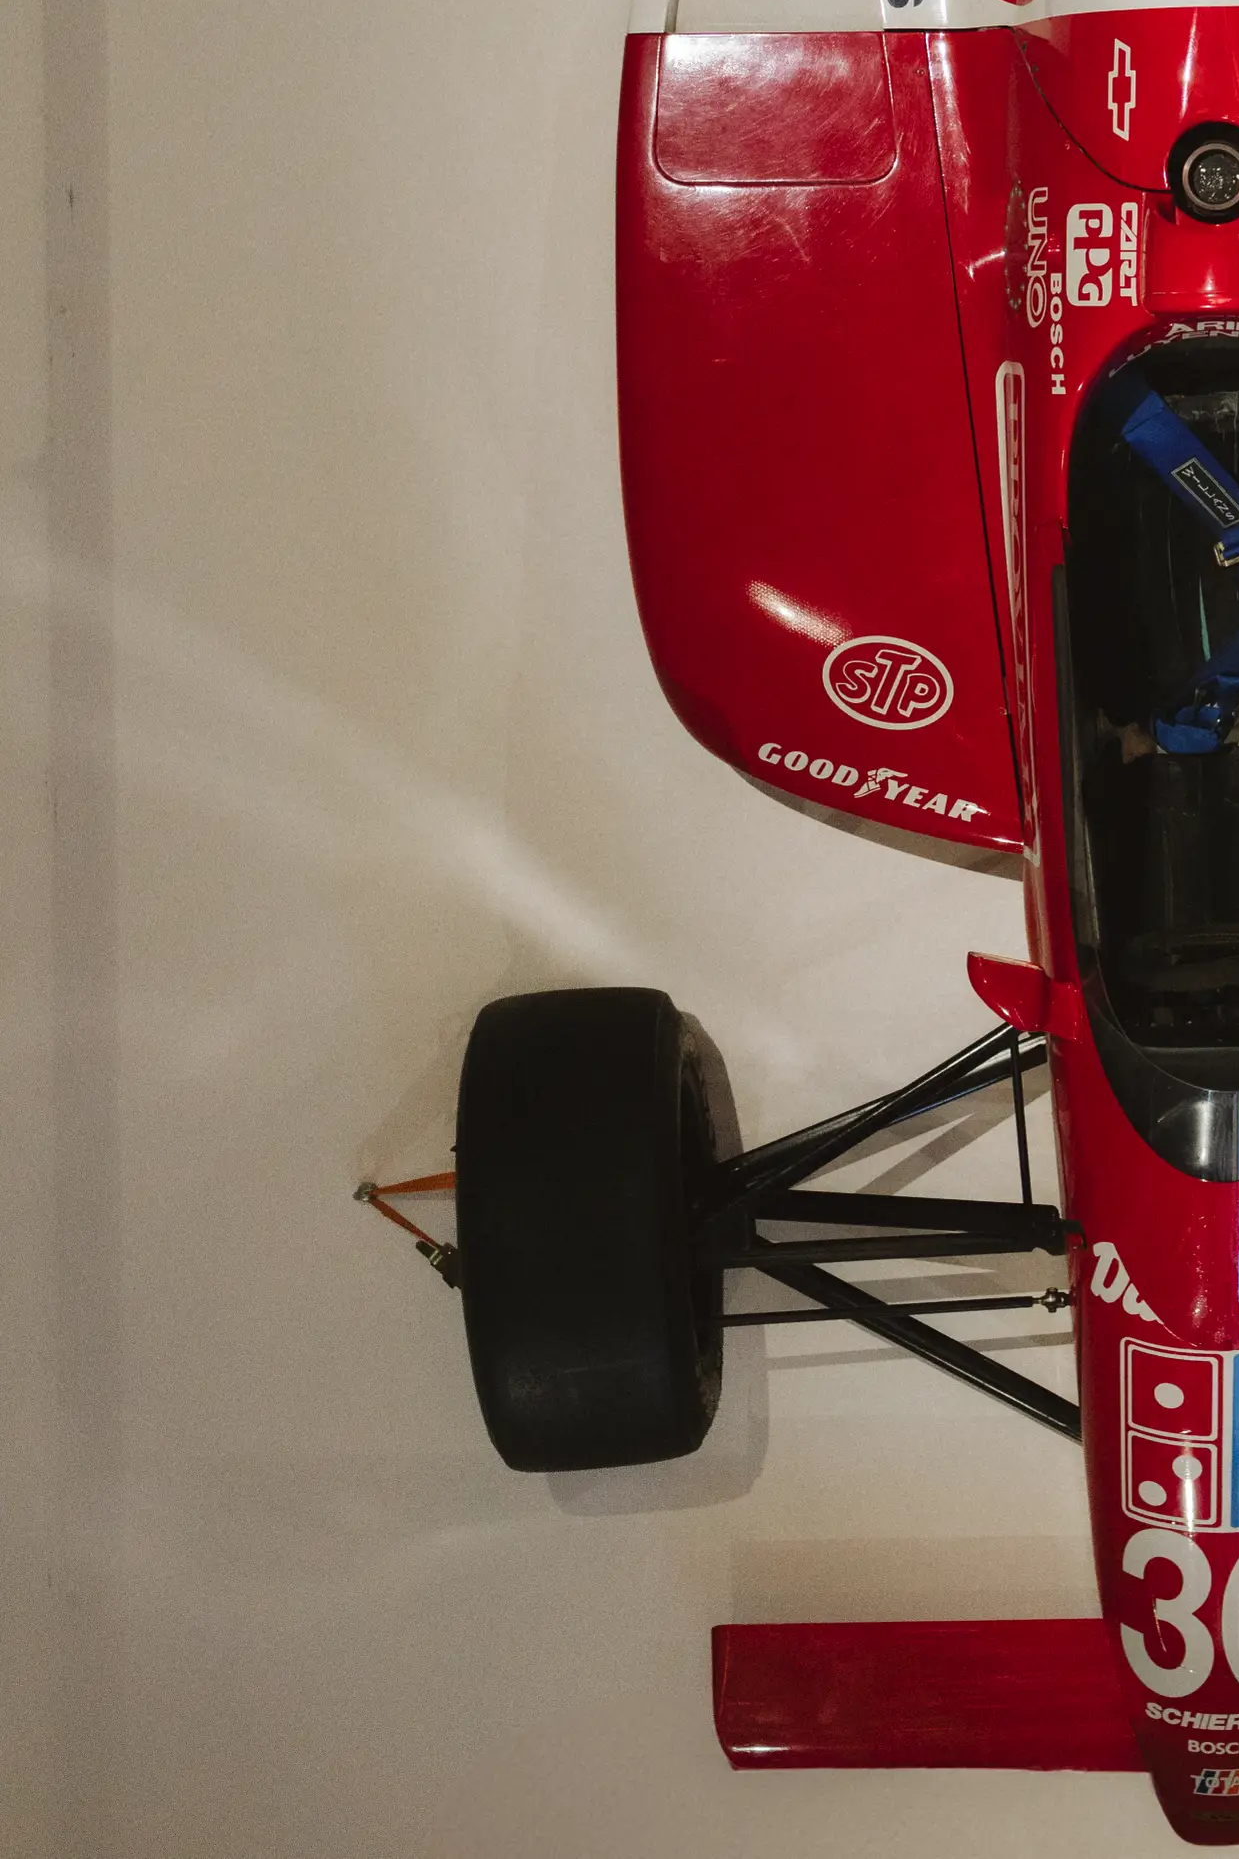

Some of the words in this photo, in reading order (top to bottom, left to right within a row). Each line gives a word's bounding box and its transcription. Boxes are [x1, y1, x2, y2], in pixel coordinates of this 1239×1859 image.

[1026, 187, 1048, 328] UNO
[1119, 202, 1138, 307] CART
[1050, 273, 1066, 395] BOSCH
[1181, 465, 1235, 521] WILLANS
[835, 649, 940, 718] STP
